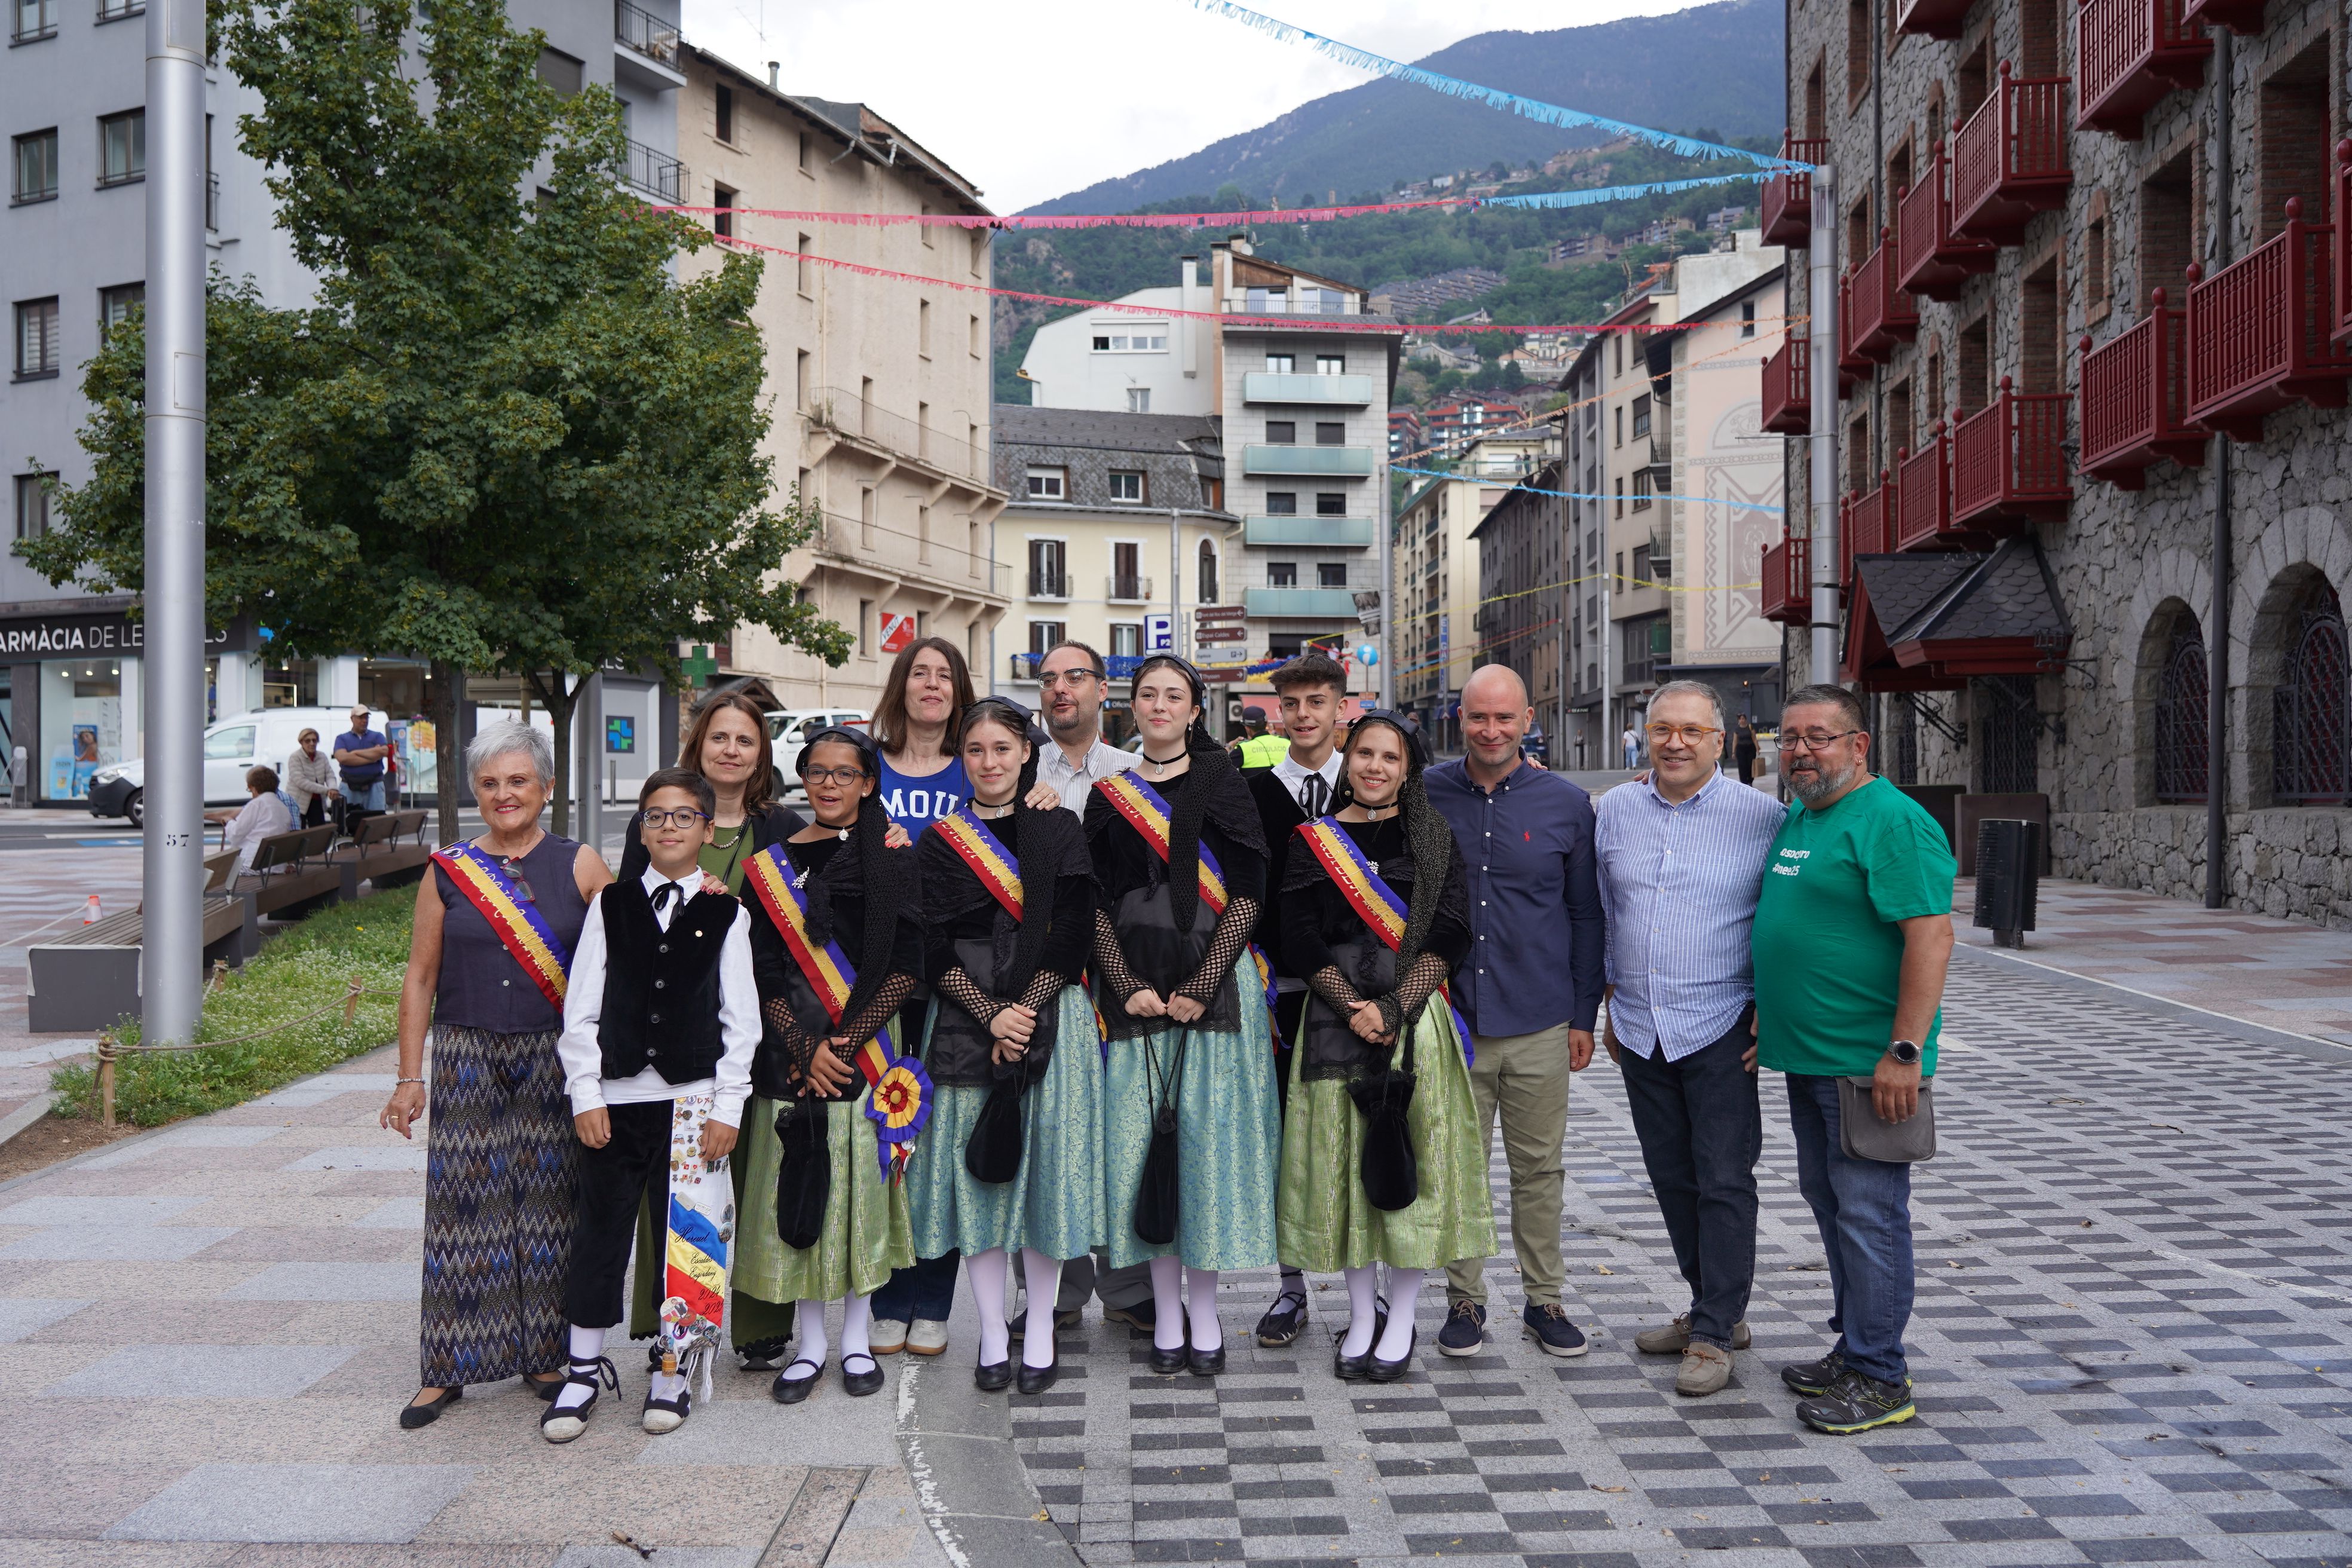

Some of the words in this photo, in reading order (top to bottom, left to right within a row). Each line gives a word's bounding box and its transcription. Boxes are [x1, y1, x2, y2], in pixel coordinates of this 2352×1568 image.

[89, 625, 115, 648] DE
[121, 624, 143, 647] LE
[1147, 615, 1171, 649] P
[1160, 638, 1171, 647] P2
[880, 789, 959, 820] MOU
[167, 834, 189, 847] 57
